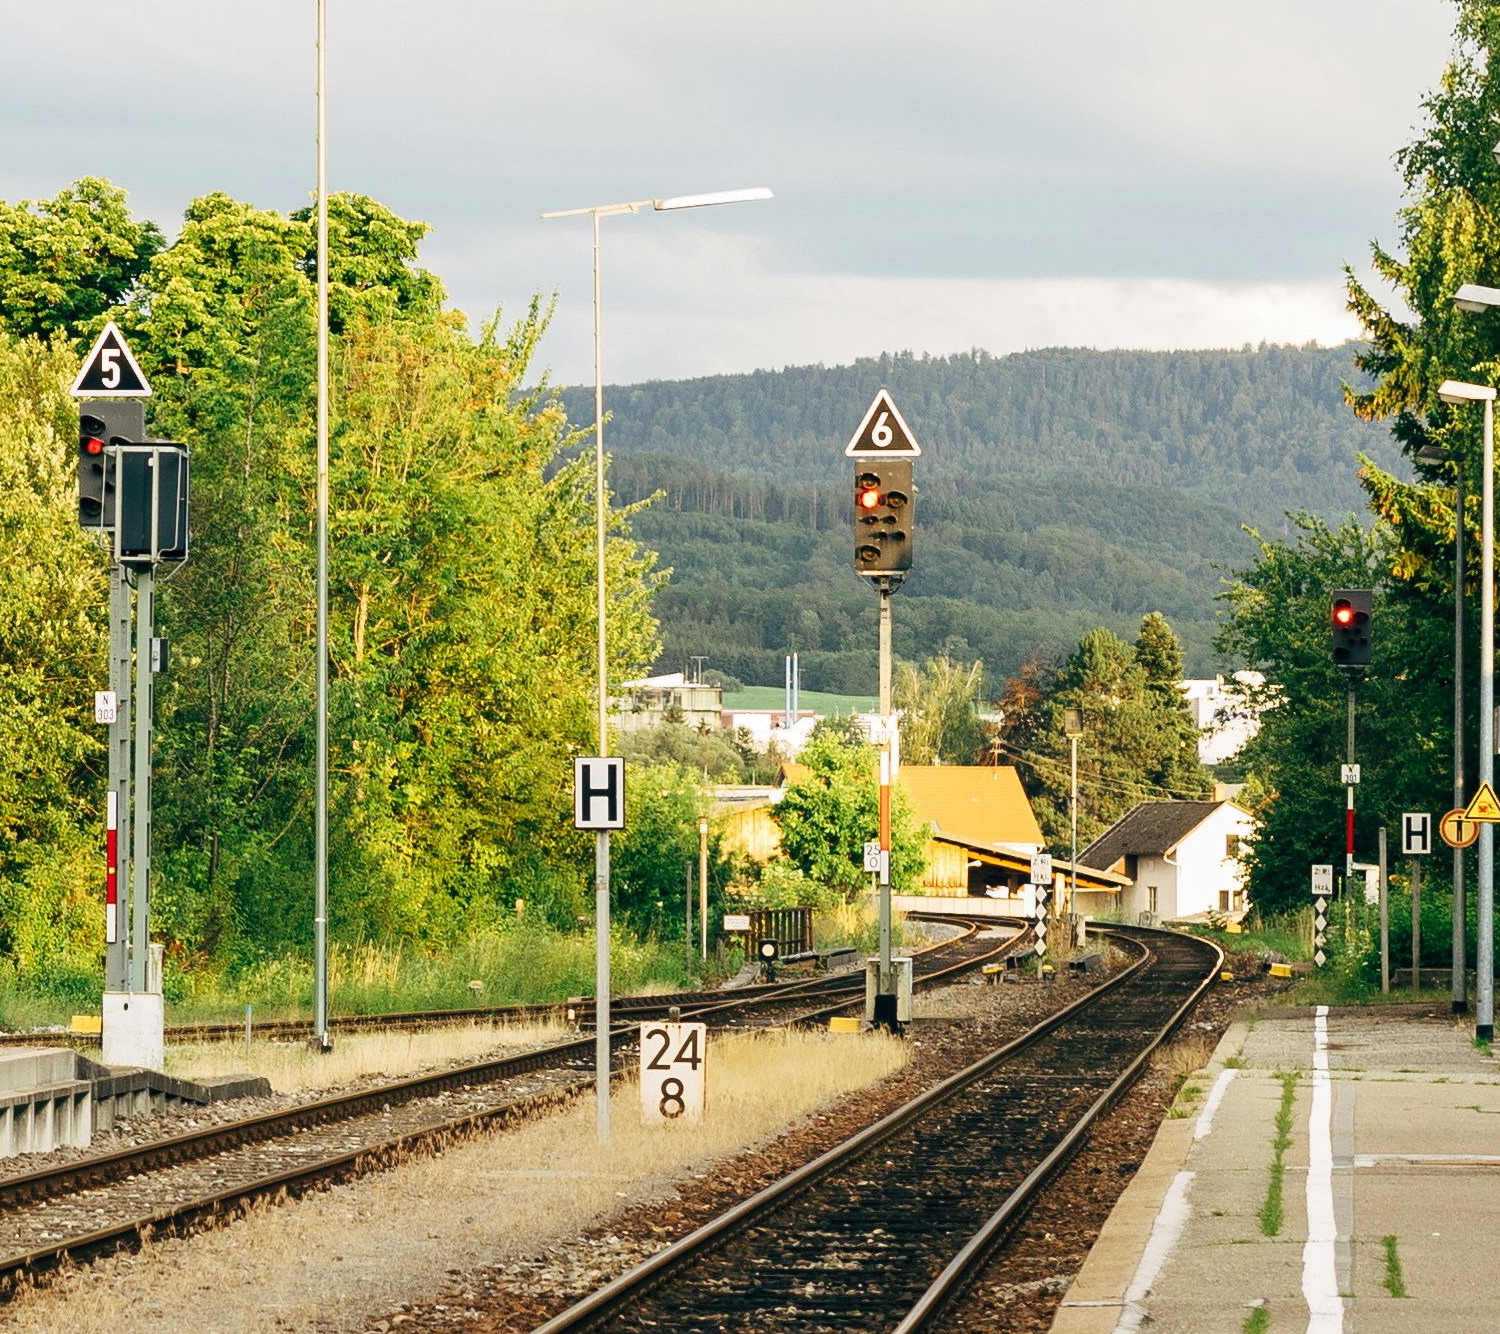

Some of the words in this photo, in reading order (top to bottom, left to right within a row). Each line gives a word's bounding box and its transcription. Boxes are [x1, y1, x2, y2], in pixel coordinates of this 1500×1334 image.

[101, 348, 121, 389] 5
[871, 411, 893, 448] 6
[97, 709, 114, 720] 303
[103, 695, 109, 705] N
[581, 763, 618, 822] H
[866, 844, 881, 856] 25
[1405, 816, 1428, 851] H
[869, 856, 878, 868] 0
[645, 1028, 703, 1071] 24
[659, 1076, 686, 1119] 8
